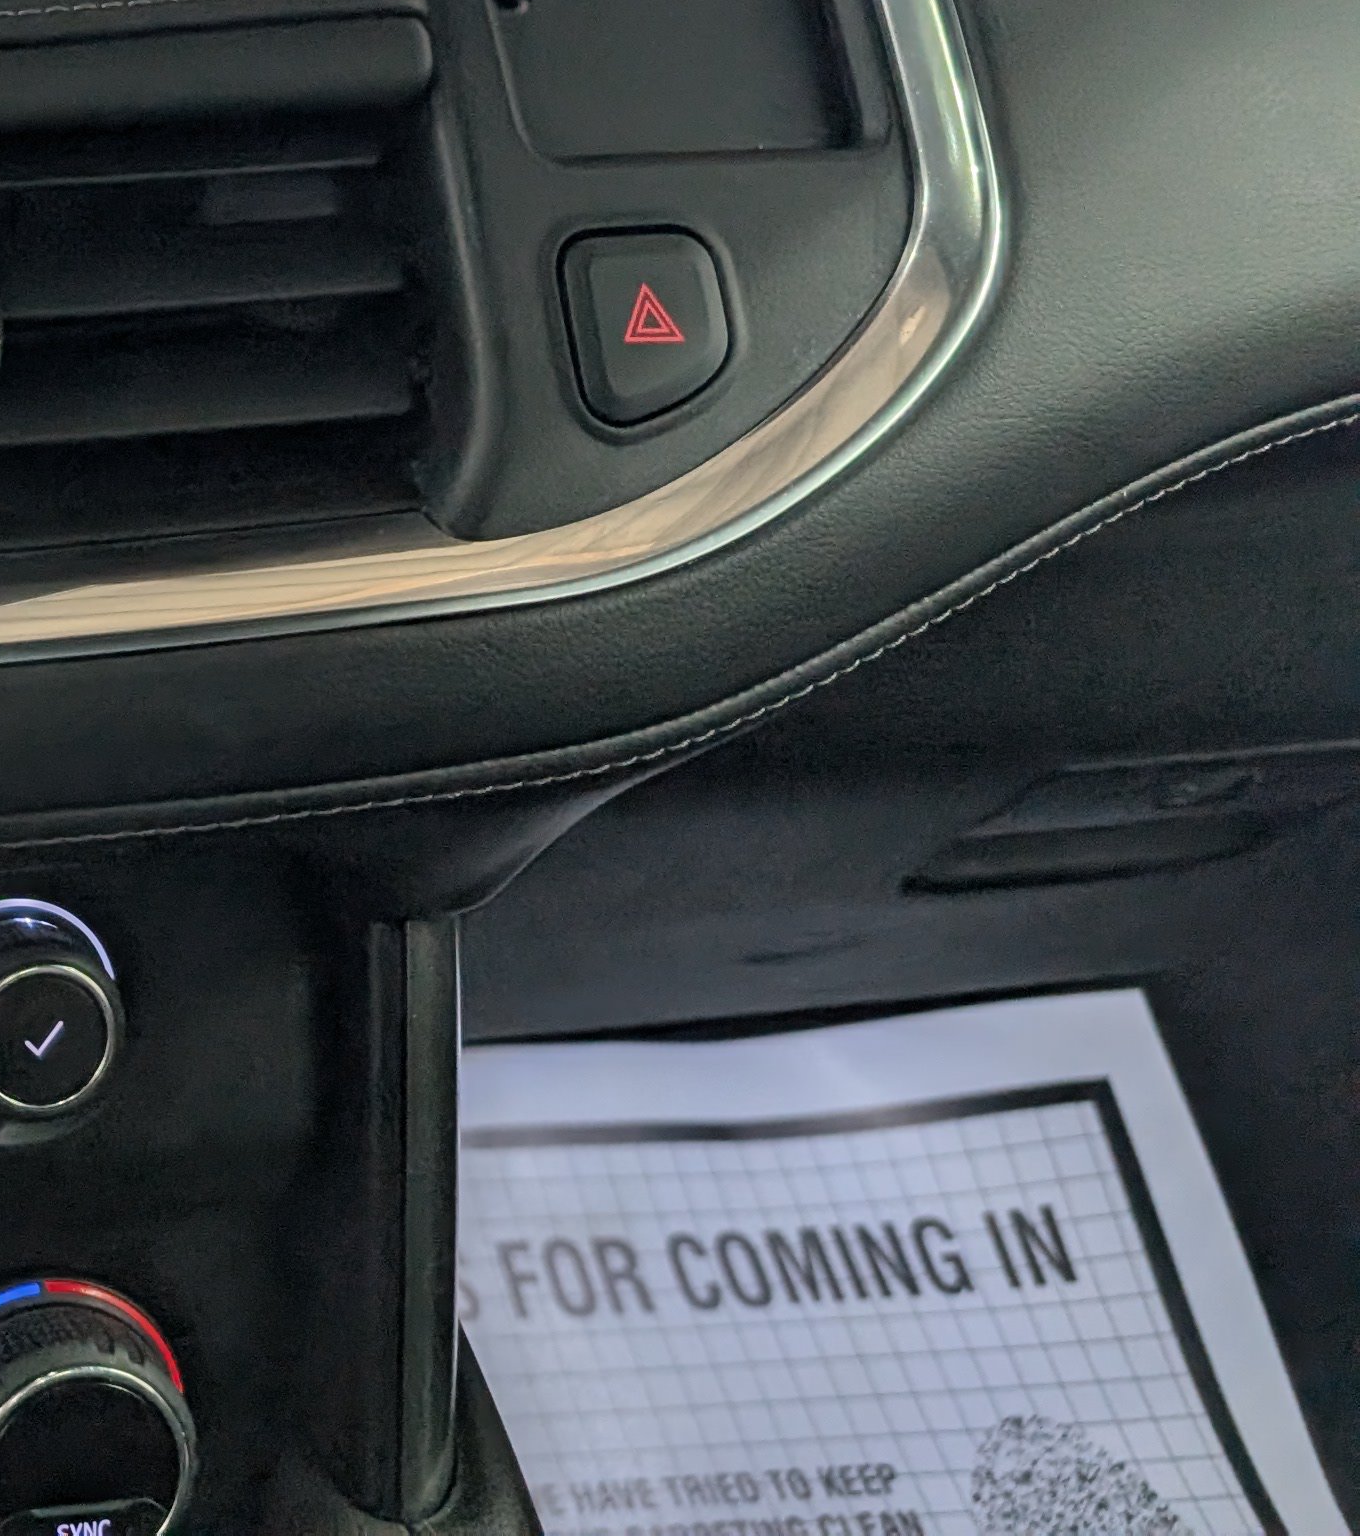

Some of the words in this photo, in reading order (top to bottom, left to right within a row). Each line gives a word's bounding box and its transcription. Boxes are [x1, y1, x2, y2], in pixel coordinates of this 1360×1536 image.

[496, 1236, 656, 1319] FOR
[667, 1217, 974, 1310] COMING
[984, 1203, 1079, 1289] IN
[570, 1476, 658, 1514] HAVE
[663, 1470, 760, 1507] TRIED
[768, 1467, 813, 1500] TO
[817, 1462, 896, 1497] KEEP
